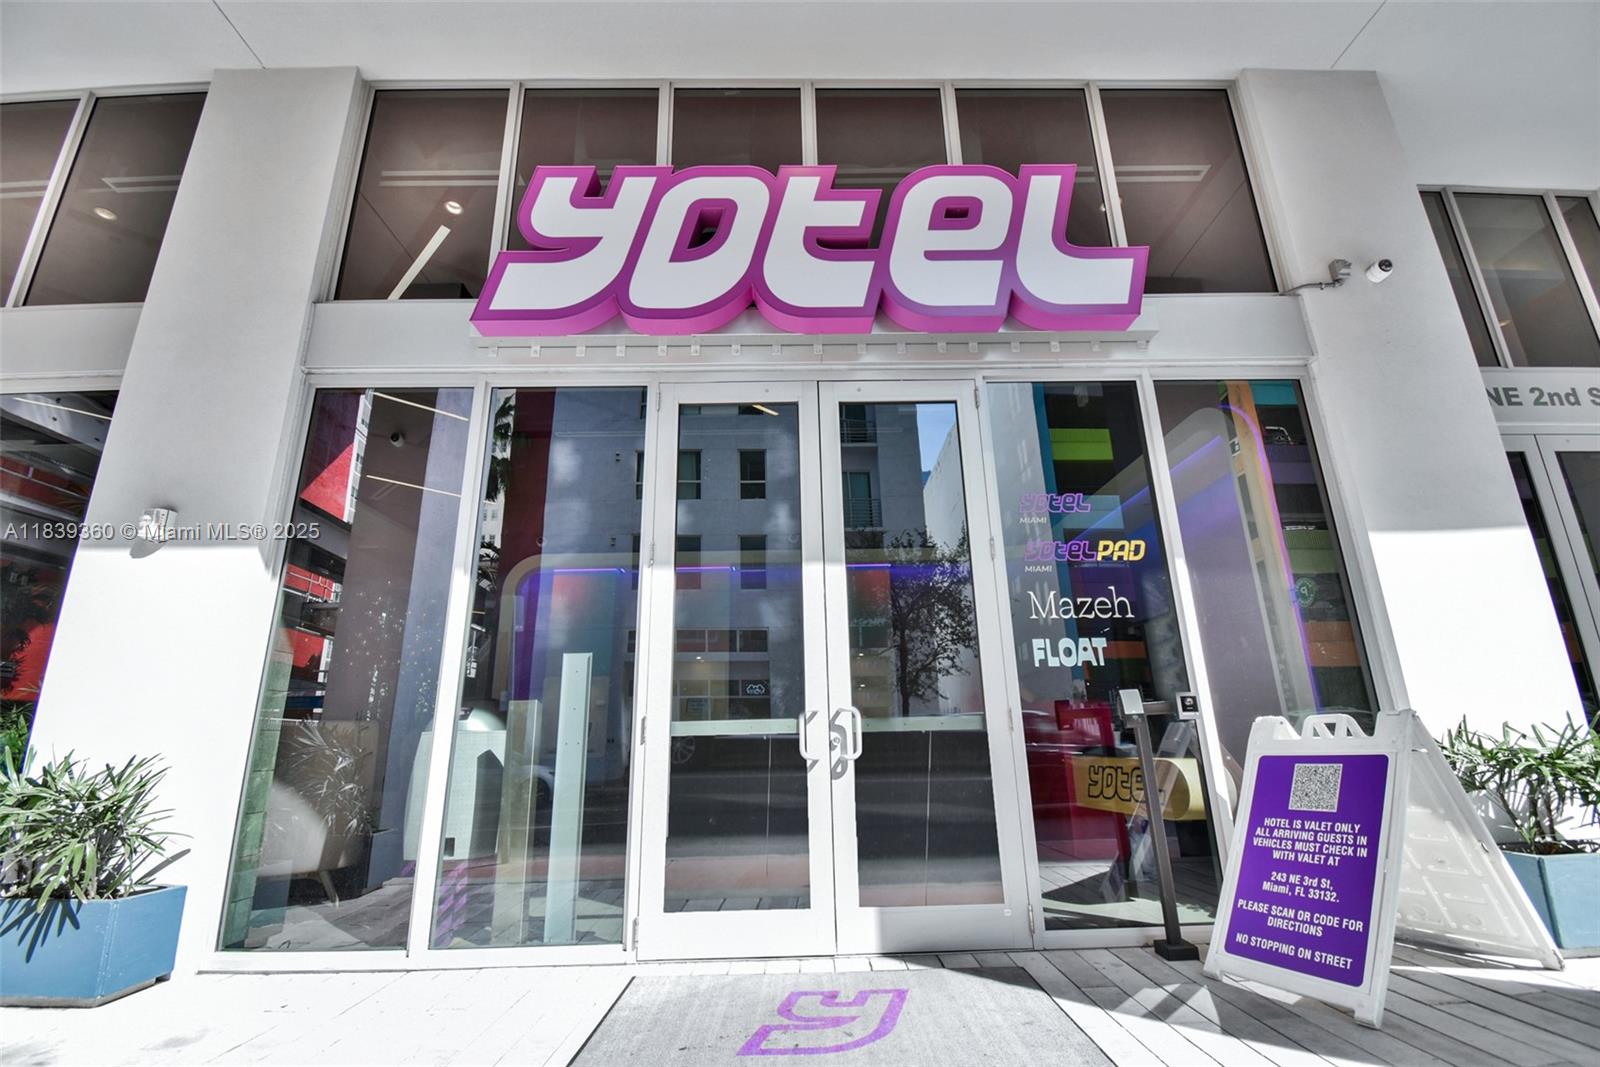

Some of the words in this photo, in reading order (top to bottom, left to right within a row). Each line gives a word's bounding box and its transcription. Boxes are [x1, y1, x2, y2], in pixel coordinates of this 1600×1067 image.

[1485, 387, 1524, 406] NE
[1529, 387, 1582, 406] 2nd
[1025, 565, 1053, 573] MIAMI
[1027, 585, 1135, 619] Mazeh
[1031, 637, 1108, 668] FLOAT
[1264, 817, 1291, 829] HOTEL
[1292, 819, 1302, 829] IS
[1304, 820, 1333, 832] VALET
[1334, 822, 1361, 834] ONLY
[1253, 836, 1293, 850] VEHICLES
[1294, 841, 1321, 853] MUST
[1322, 844, 1354, 857] CHECK
[1356, 847, 1368, 858] IN
[1255, 827, 1271, 837] ALL
[1272, 829, 1315, 842] ARRIVING
[1316, 832, 1354, 845] GUESTS
[1356, 835, 1368, 846] IN
[1272, 849, 1296, 861] WITH
[1297, 852, 1326, 865] VALET
[1327, 856, 1341, 866] AT
[1271, 871, 1287, 882] 243
[1288, 873, 1302, 884] NE
[1302, 875, 1319, 888] 3rd
[1320, 878, 1334, 890] St,
[1262, 881, 1293, 896] Miami,
[1294, 886, 1306, 897] FL
[1307, 889, 1341, 903] 33132.
[1237, 898, 1269, 914] PLEASE
[1270, 905, 1296, 919] SCAN
[1296, 910, 1311, 922] OR
[1313, 913, 1341, 928] CODE
[1342, 918, 1364, 932] FOR
[1267, 916, 1324, 937] DIRECTIONS
[1235, 932, 1249, 945] NO
[1249, 936, 1296, 957] STOPPING
[1297, 947, 1312, 960] ON
[1313, 951, 1353, 970] STREET
